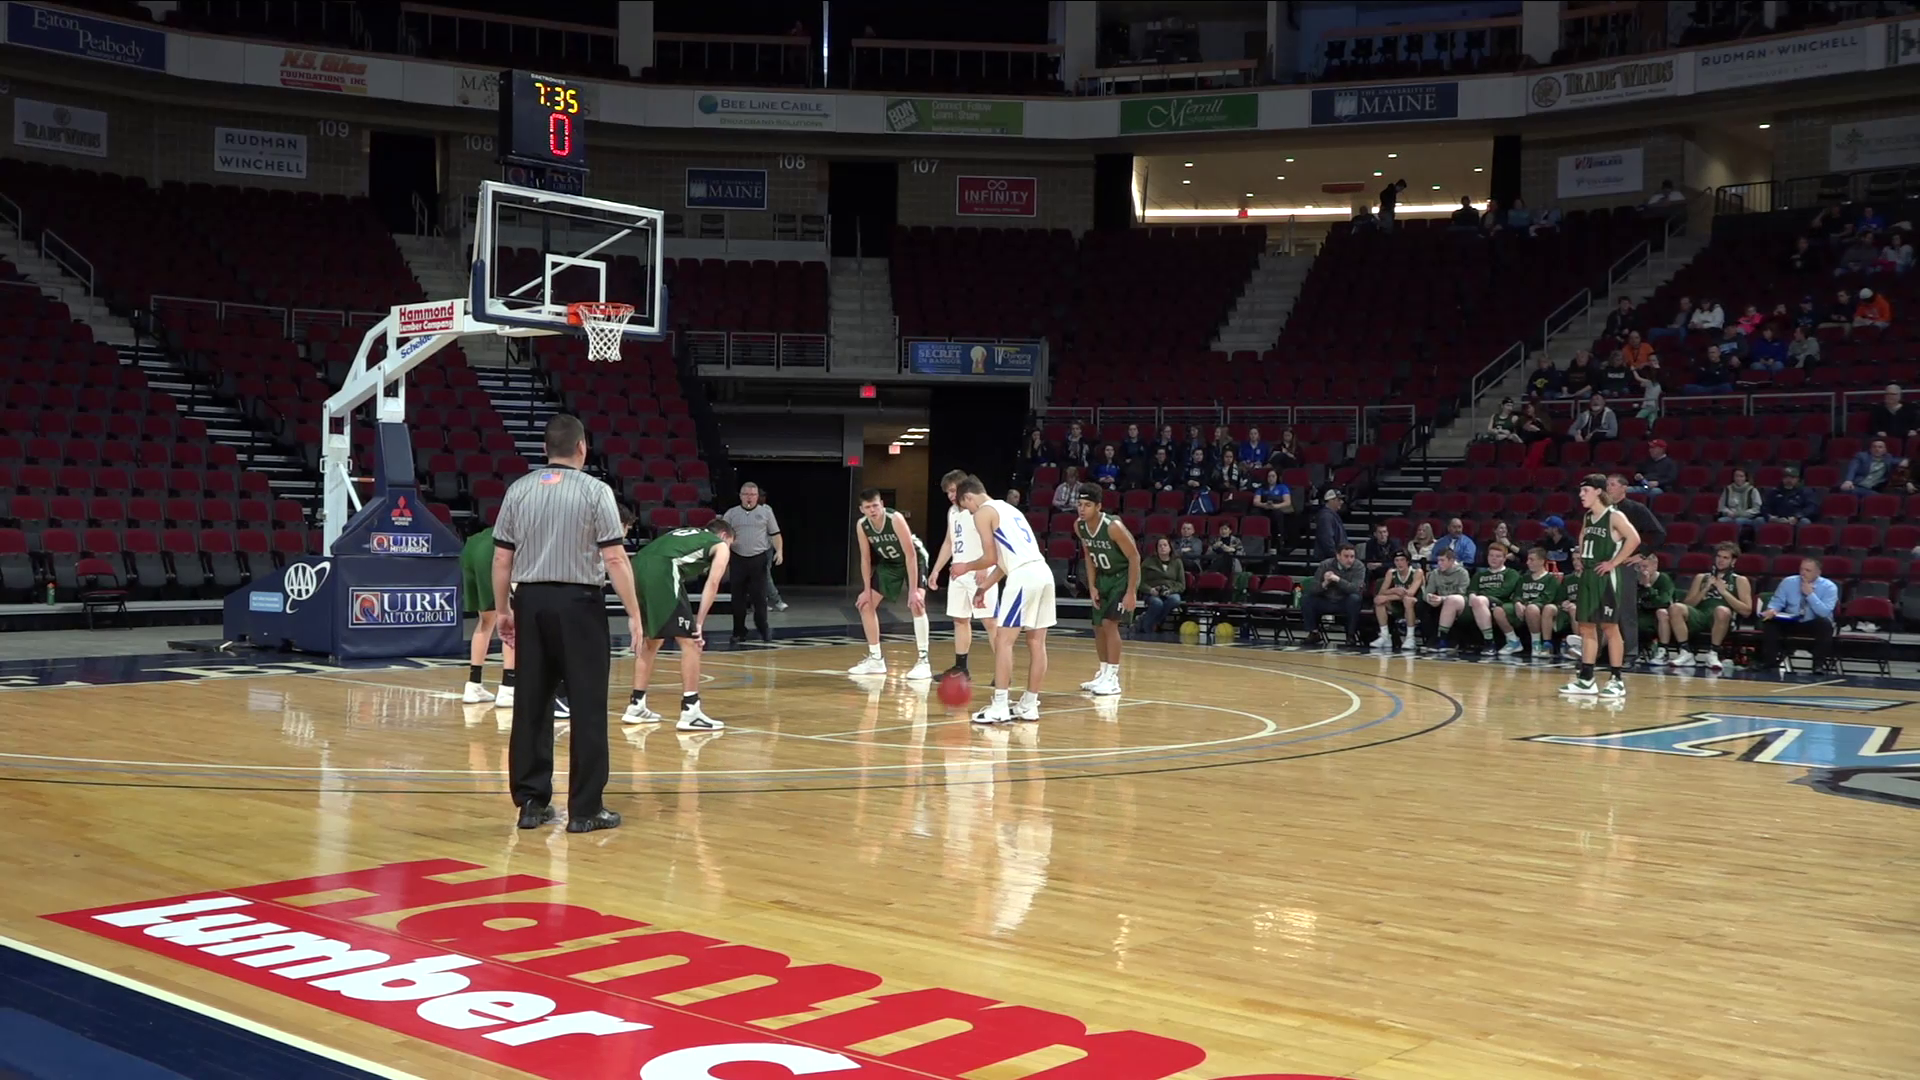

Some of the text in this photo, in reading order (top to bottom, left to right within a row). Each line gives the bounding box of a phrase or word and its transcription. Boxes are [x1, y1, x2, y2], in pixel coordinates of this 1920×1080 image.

[32, 8, 80, 30] Eaton
[78, 29, 145, 62] Peabody
[1701, 36, 1858, 66] RUDMAN WINCHELL
[280, 70, 345, 83] FOUNDATIONS
[534, 82, 580, 114] 7:35
[721, 98, 823, 111] BEE LINE CABLE
[1360, 93, 1437, 115] MAINE
[888, 100, 914, 124] BDN
[1147, 98, 1225, 128] Merrill
[317, 120, 350, 138] 109
[549, 112, 571, 156] 0
[225, 133, 298, 150] RUDMAN
[463, 135, 494, 151] 108
[219, 156, 303, 173] WINCHELL
[776, 154, 806, 170] 108
[910, 159, 940, 174] 107
[708, 185, 763, 199] MAINE
[965, 189, 1029, 203] INFINITY
[399, 302, 454, 321] Hammond
[918, 349, 962, 358] SECRET
[1013, 516, 1032, 544] 5
[373, 535, 429, 550] QUIRK
[1581, 540, 1594, 559] 11
[877, 545, 900, 559] 12
[355, 592, 453, 623] QUIRK
[382, 611, 454, 623] AUTO GROUP
[678, 616, 691, 631] PV
[92, 896, 654, 1047] Lumber
